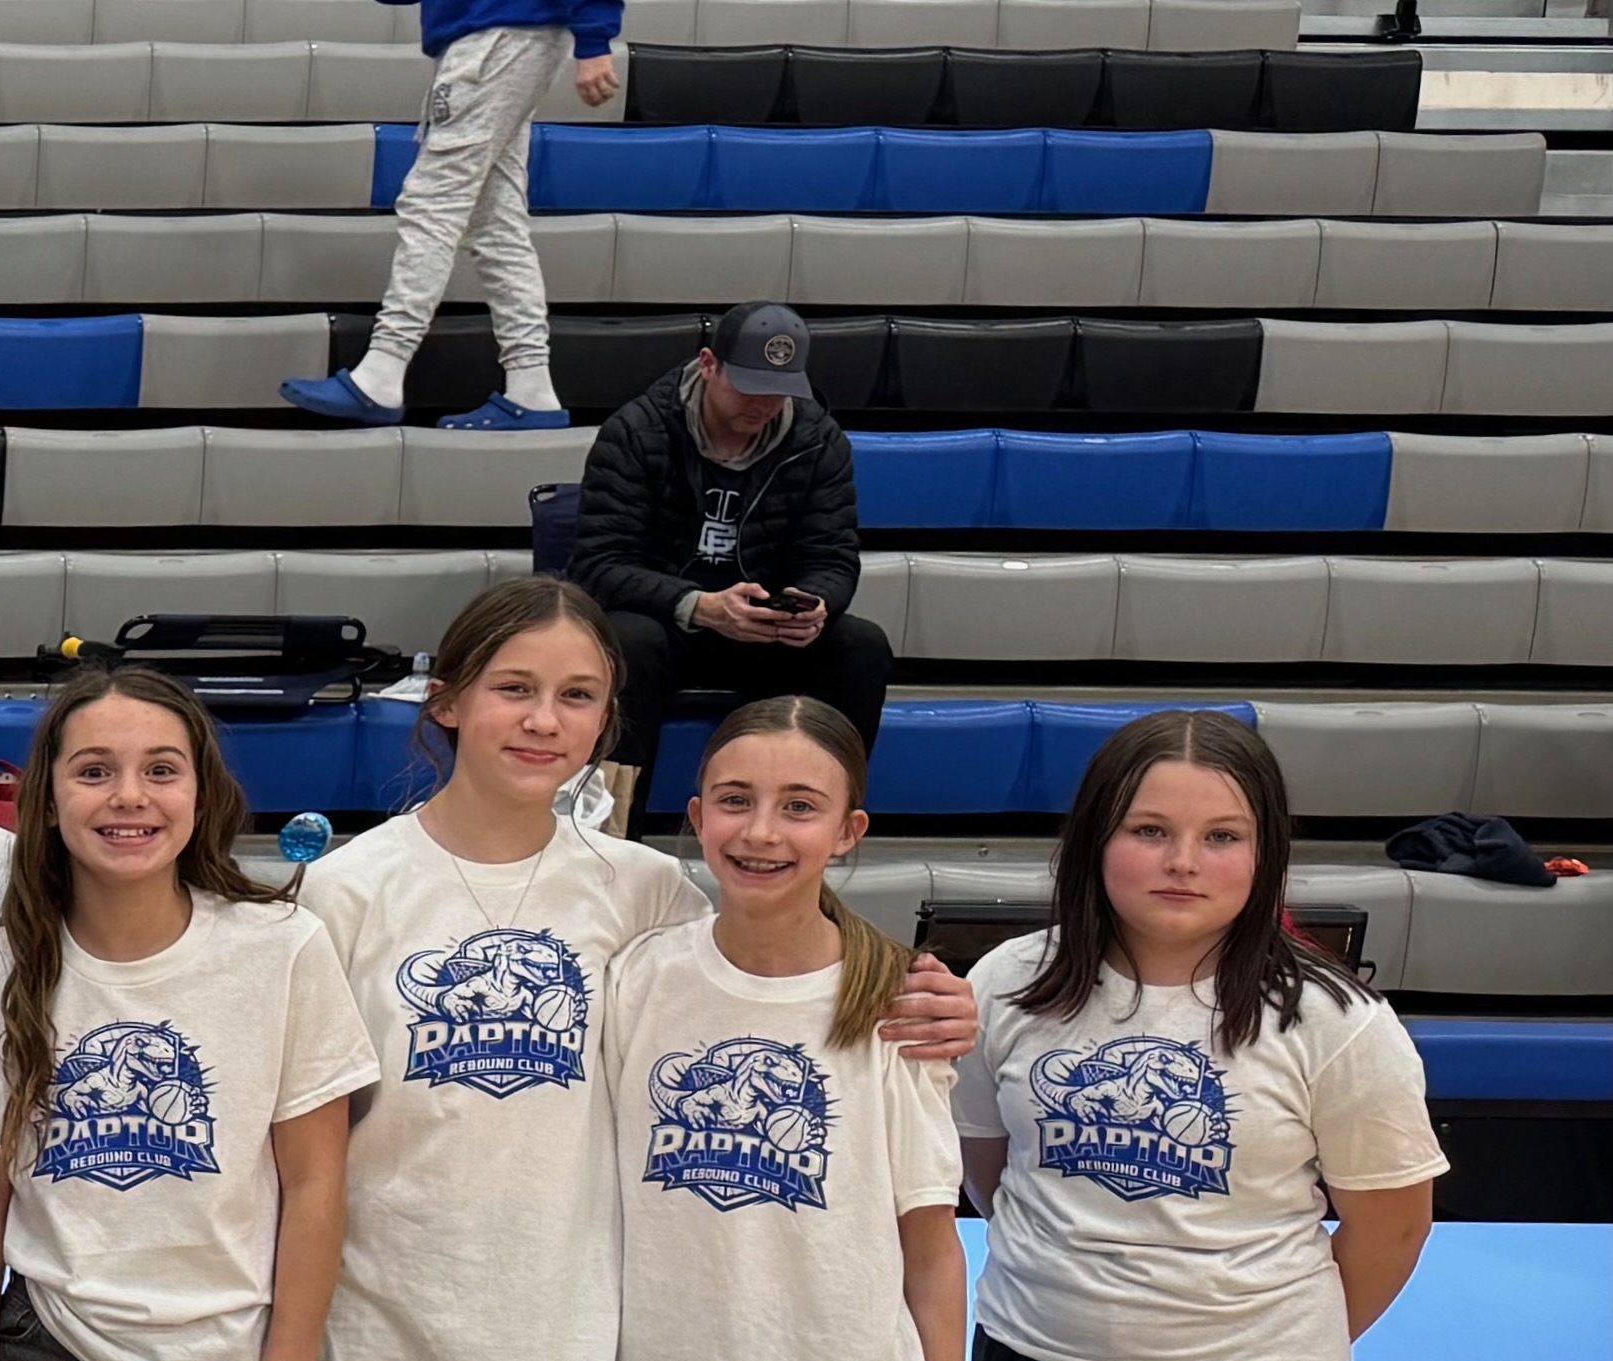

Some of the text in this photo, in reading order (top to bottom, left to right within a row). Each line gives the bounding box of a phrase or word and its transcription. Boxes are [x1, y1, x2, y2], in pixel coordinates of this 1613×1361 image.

[409, 1021, 584, 1076] RAPTOR
[449, 1058, 555, 1075] REBOUND CLUB
[69, 1151, 172, 1170] REBOUND CLUB
[648, 1126, 823, 1202] RAPTOR
[1041, 1120, 1226, 1191] RAPTOR
[682, 1168, 780, 1195] REBOUND CLUB
[1077, 1160, 1182, 1187] REBOUND CLUB
